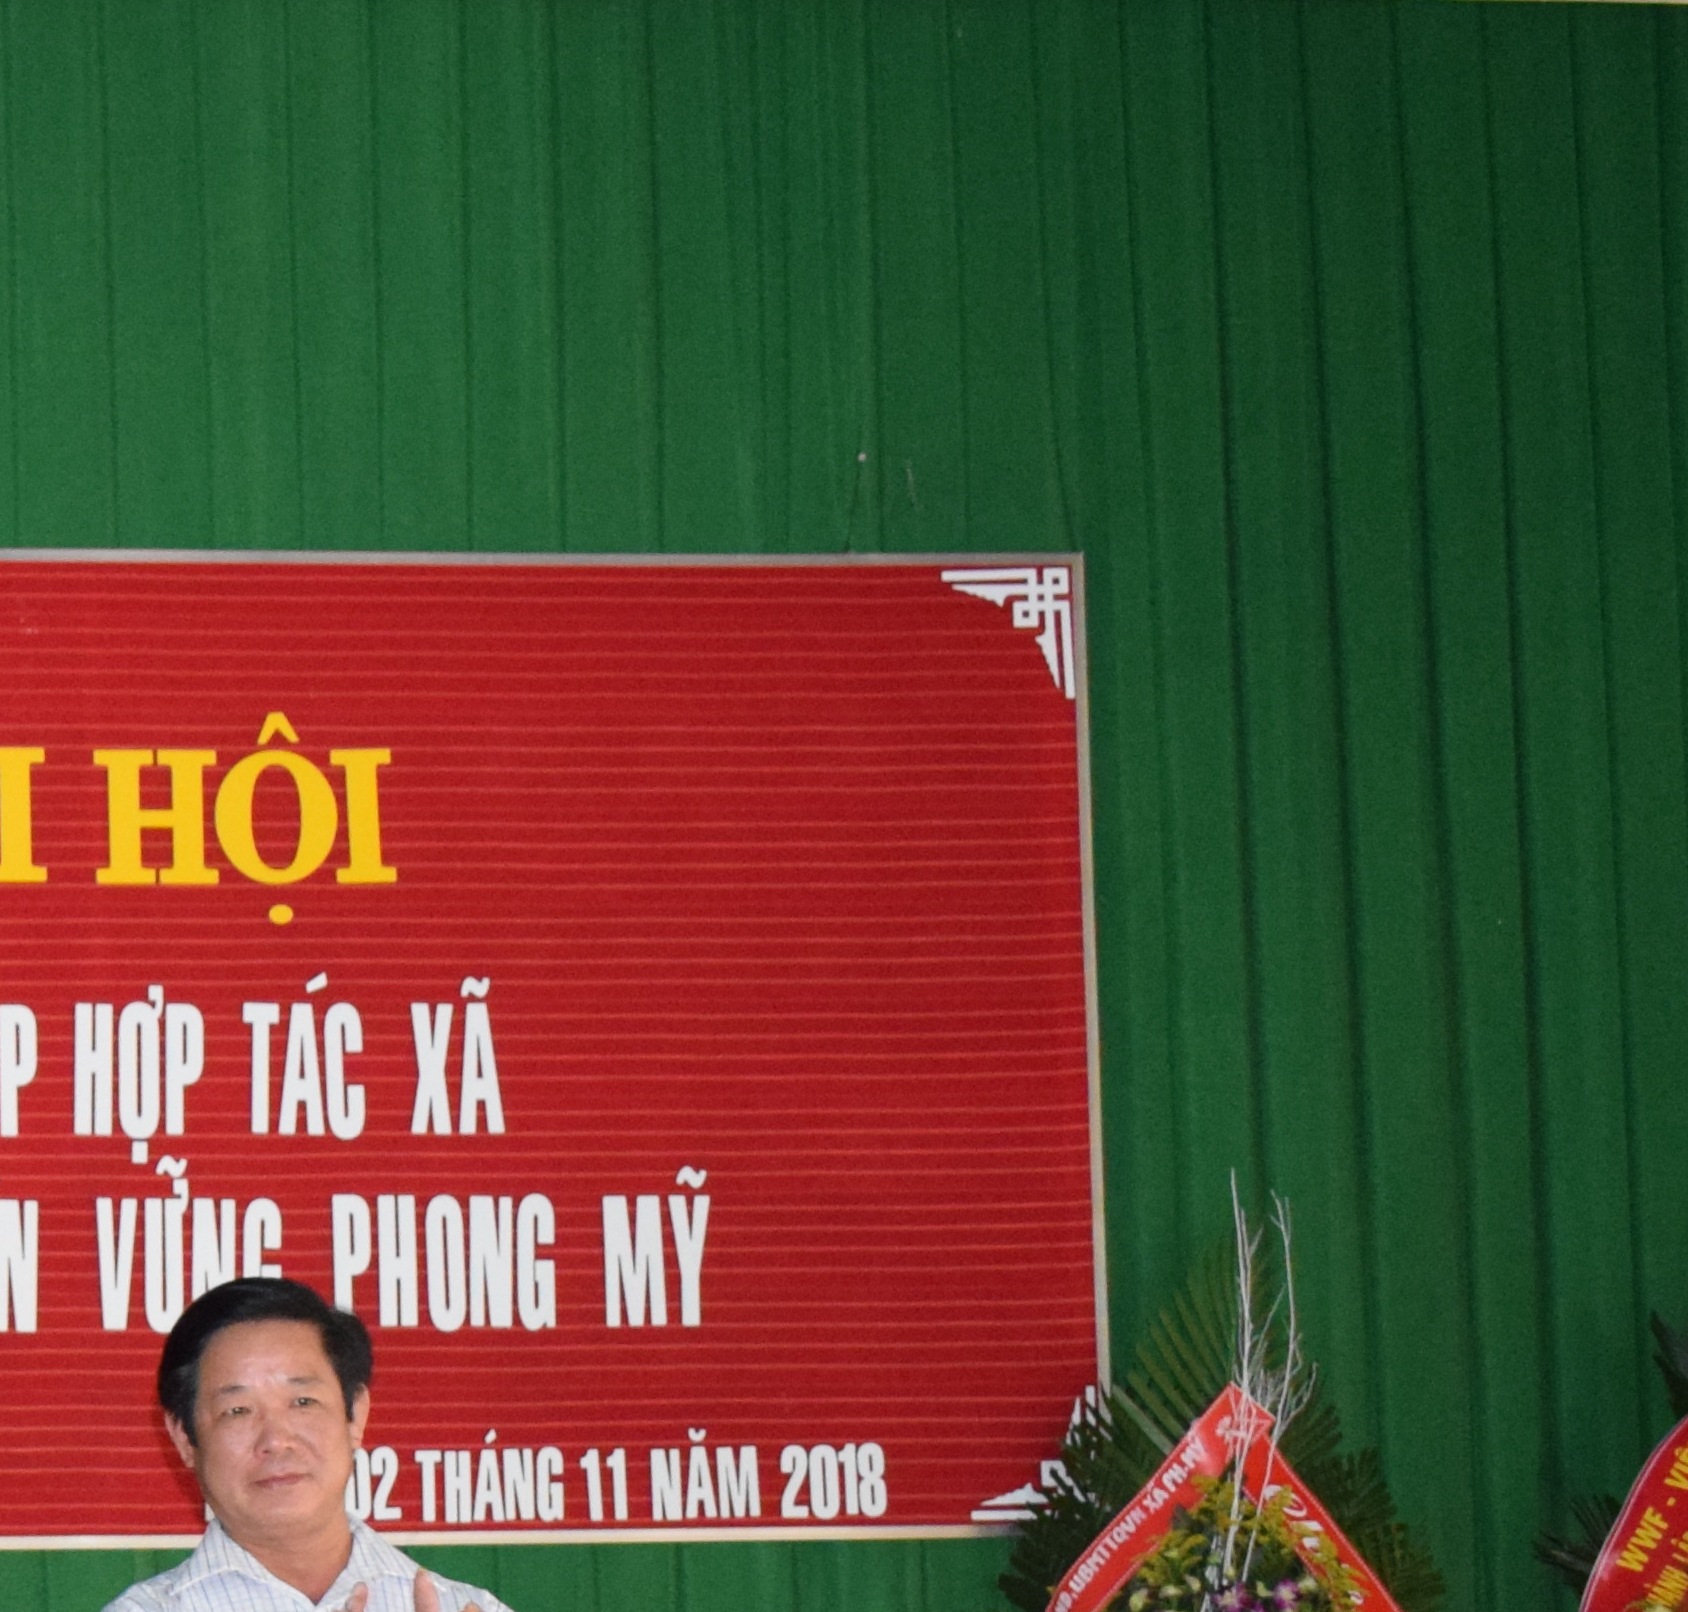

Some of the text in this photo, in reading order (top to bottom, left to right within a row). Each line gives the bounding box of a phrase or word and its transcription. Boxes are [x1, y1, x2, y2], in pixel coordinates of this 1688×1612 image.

[93, 712, 397, 925] HỘI
[73, 984, 205, 1165] HỢP
[242, 971, 366, 1141] TÁC
[410, 976, 506, 1137] XÃ
[95, 1154, 283, 1334] VỮNG
[331, 1193, 557, 1333] PHONG
[602, 1165, 712, 1328] MỸ
[344, 1427, 888, 1524] 02 THÁNG 11 NĂM 2018
[1615, 1506, 1669, 1572] WWF
